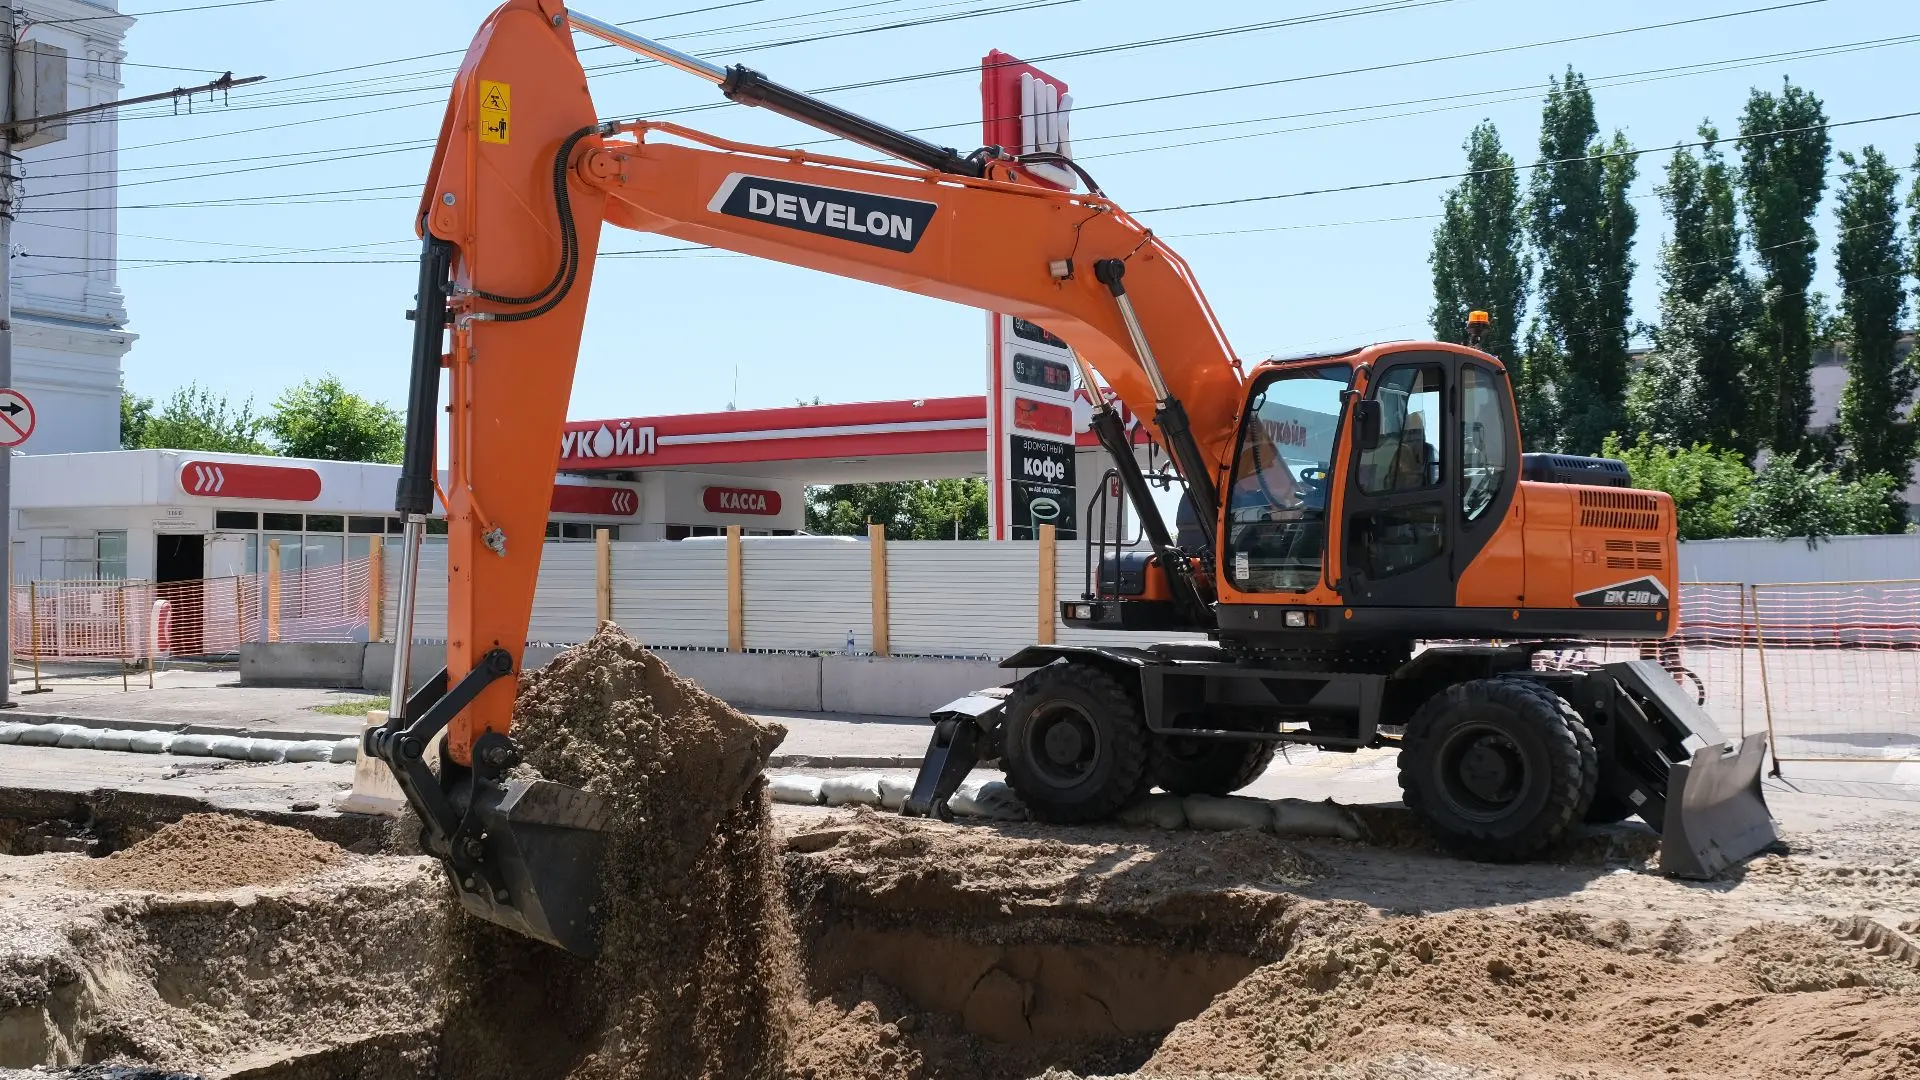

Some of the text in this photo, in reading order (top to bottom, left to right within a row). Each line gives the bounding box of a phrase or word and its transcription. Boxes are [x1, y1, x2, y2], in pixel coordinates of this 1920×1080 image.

[748, 188, 913, 241] DEVELON
[1016, 361, 1025, 375] 95
[561, 421, 655, 459] УКОЙЛ
[1023, 440, 1064, 454] ароматный
[1023, 456, 1065, 482] кофе
[720, 492, 766, 510] КАССА
